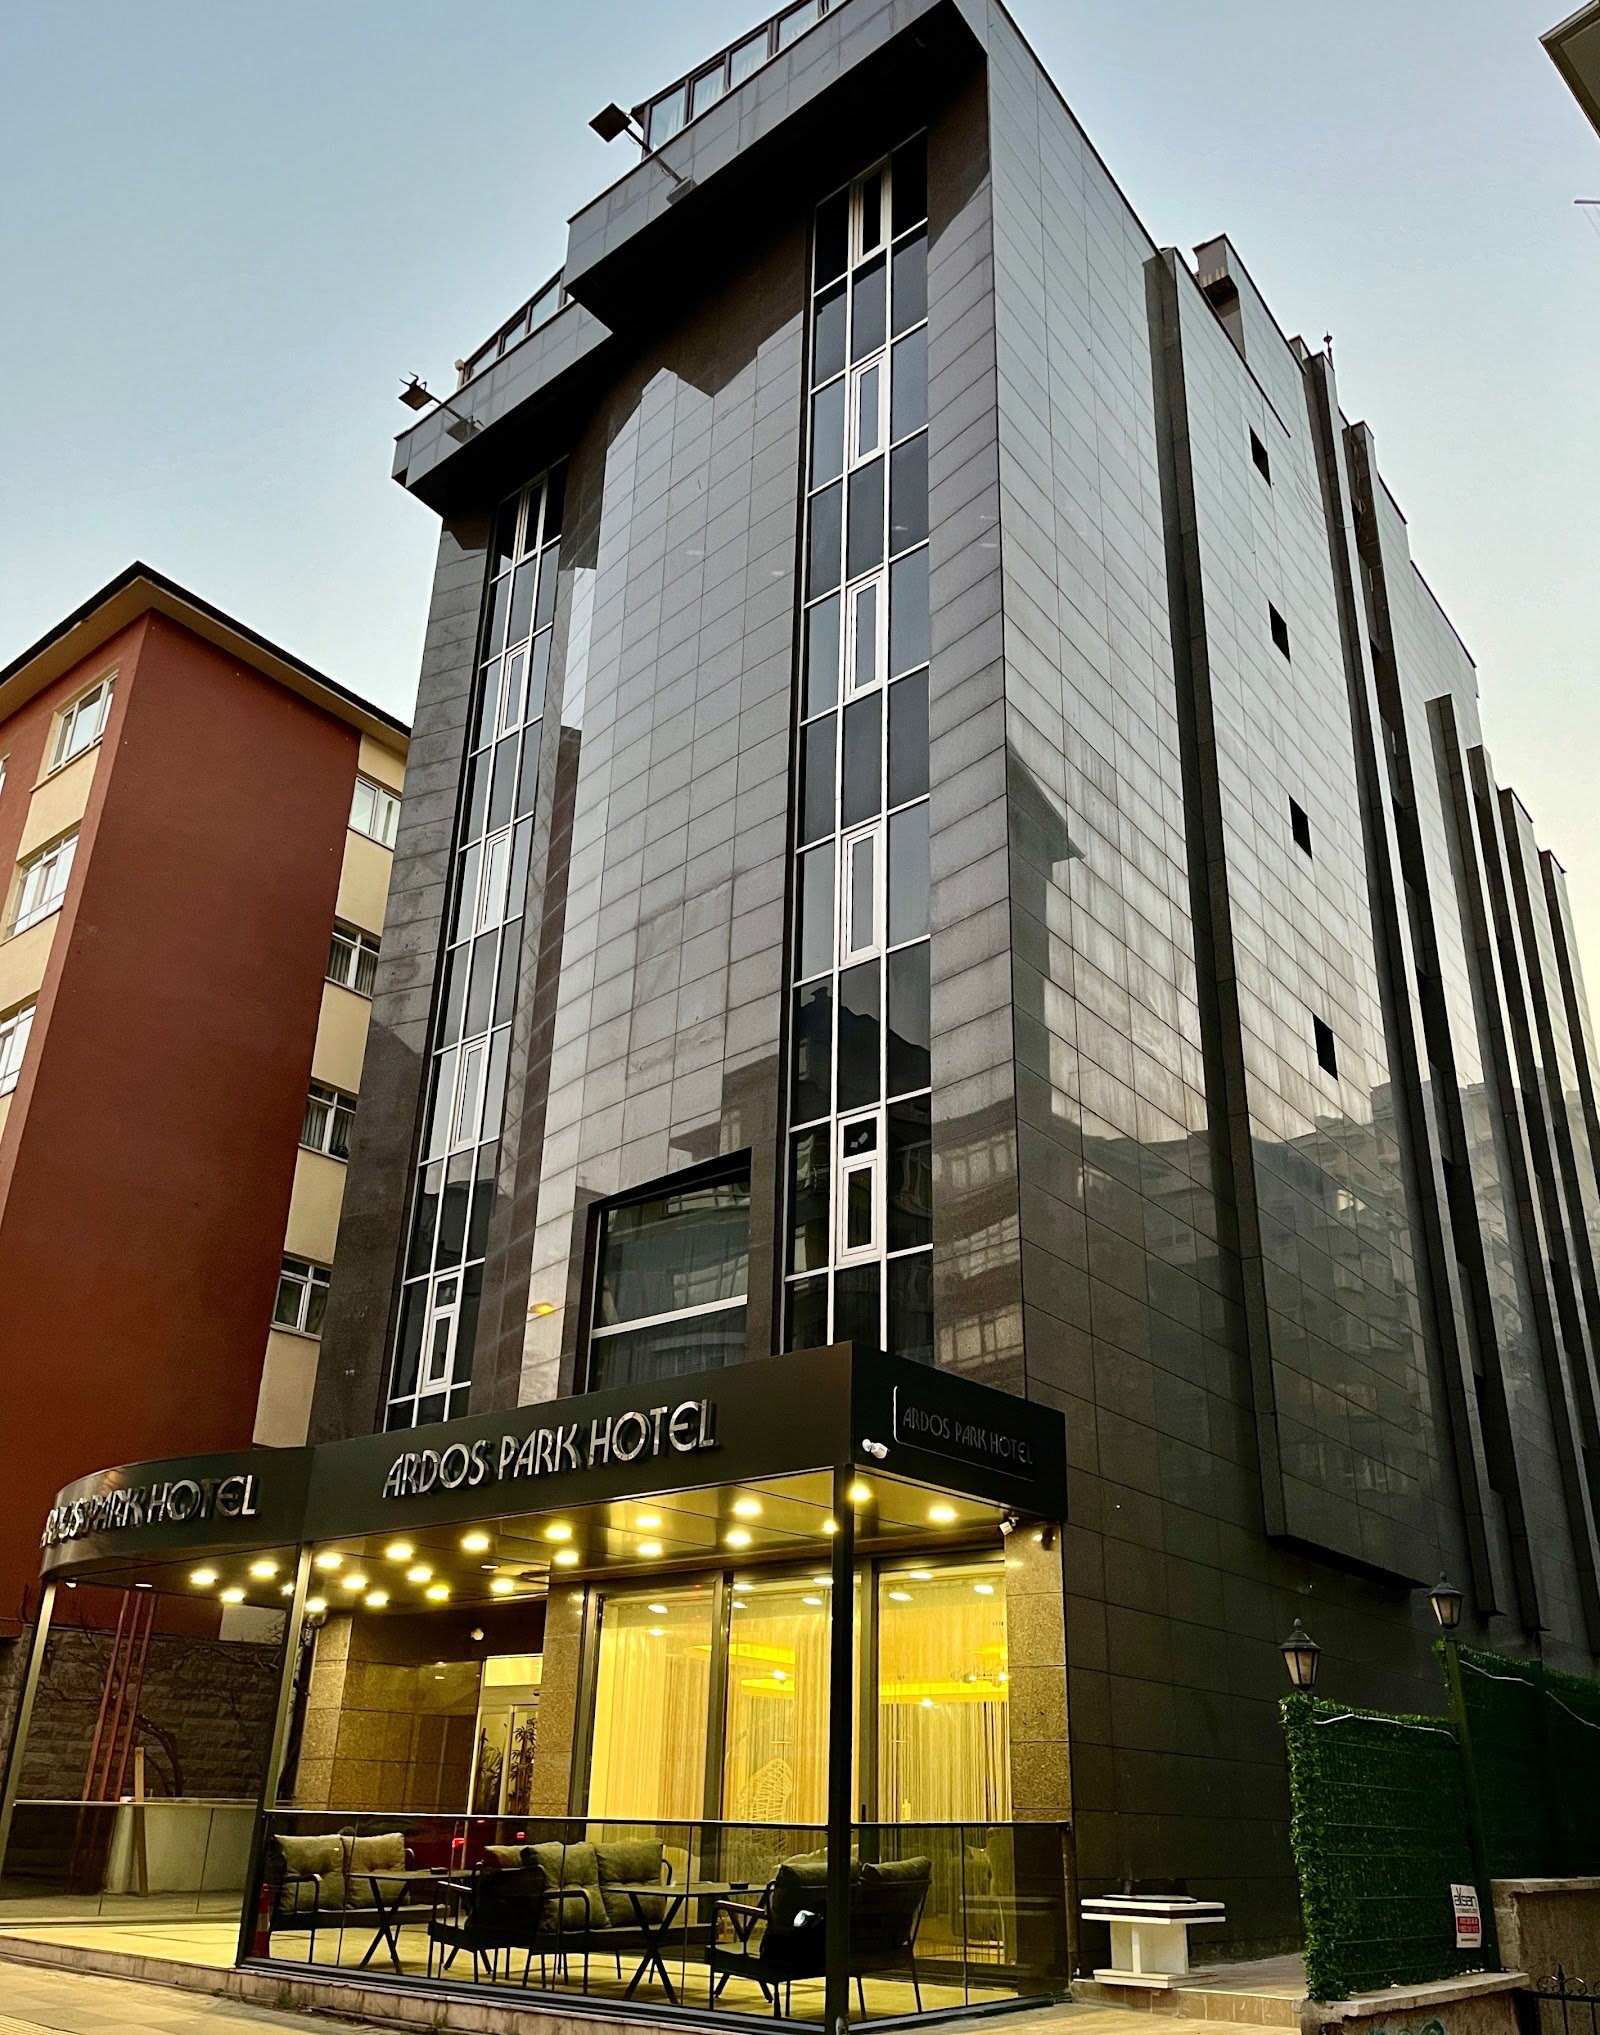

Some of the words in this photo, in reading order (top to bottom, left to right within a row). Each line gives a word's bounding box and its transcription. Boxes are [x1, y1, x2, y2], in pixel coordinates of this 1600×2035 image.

[382, 1439, 487, 1498] ARDOS
[498, 1423, 579, 1480] PARK
[588, 1398, 715, 1466] HOTEL
[903, 1406, 950, 1439] ARDOS
[955, 1421, 987, 1450] PARK
[990, 1432, 1033, 1465] HOTEL
[85, 1487, 144, 1533] PARK
[146, 1475, 256, 1523] HOTEL
